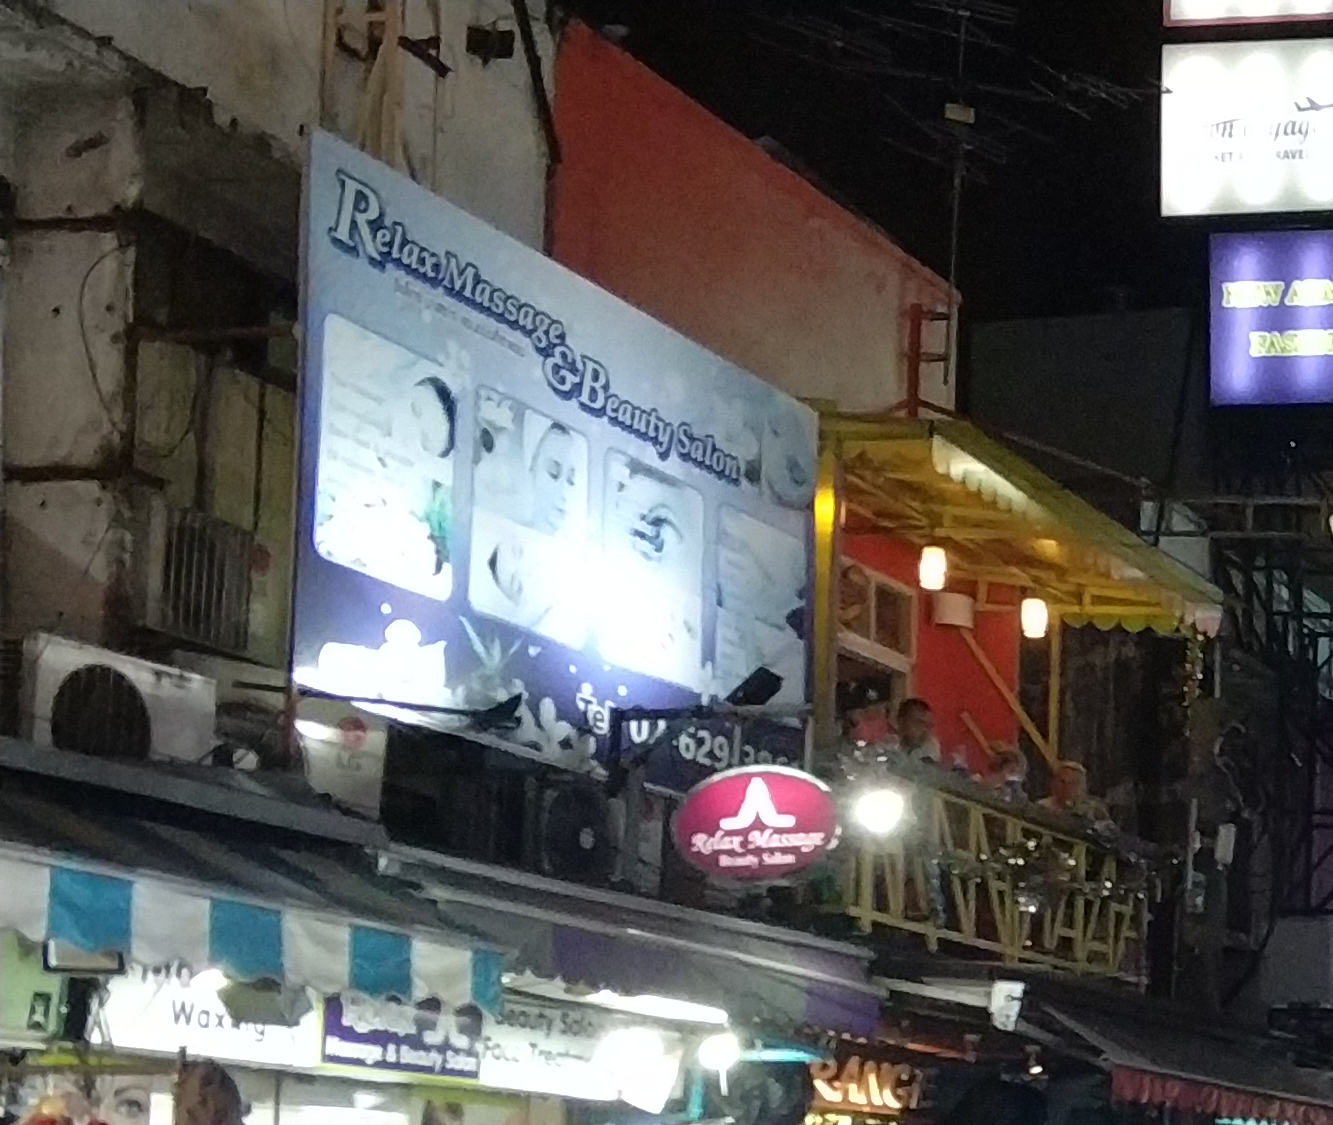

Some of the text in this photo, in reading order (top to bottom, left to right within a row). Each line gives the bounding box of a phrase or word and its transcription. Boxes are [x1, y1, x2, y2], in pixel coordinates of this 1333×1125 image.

[328, 167, 441, 286] Relax
[442, 249, 567, 356] Massage
[542, 343, 742, 487] & Beauty Salon
